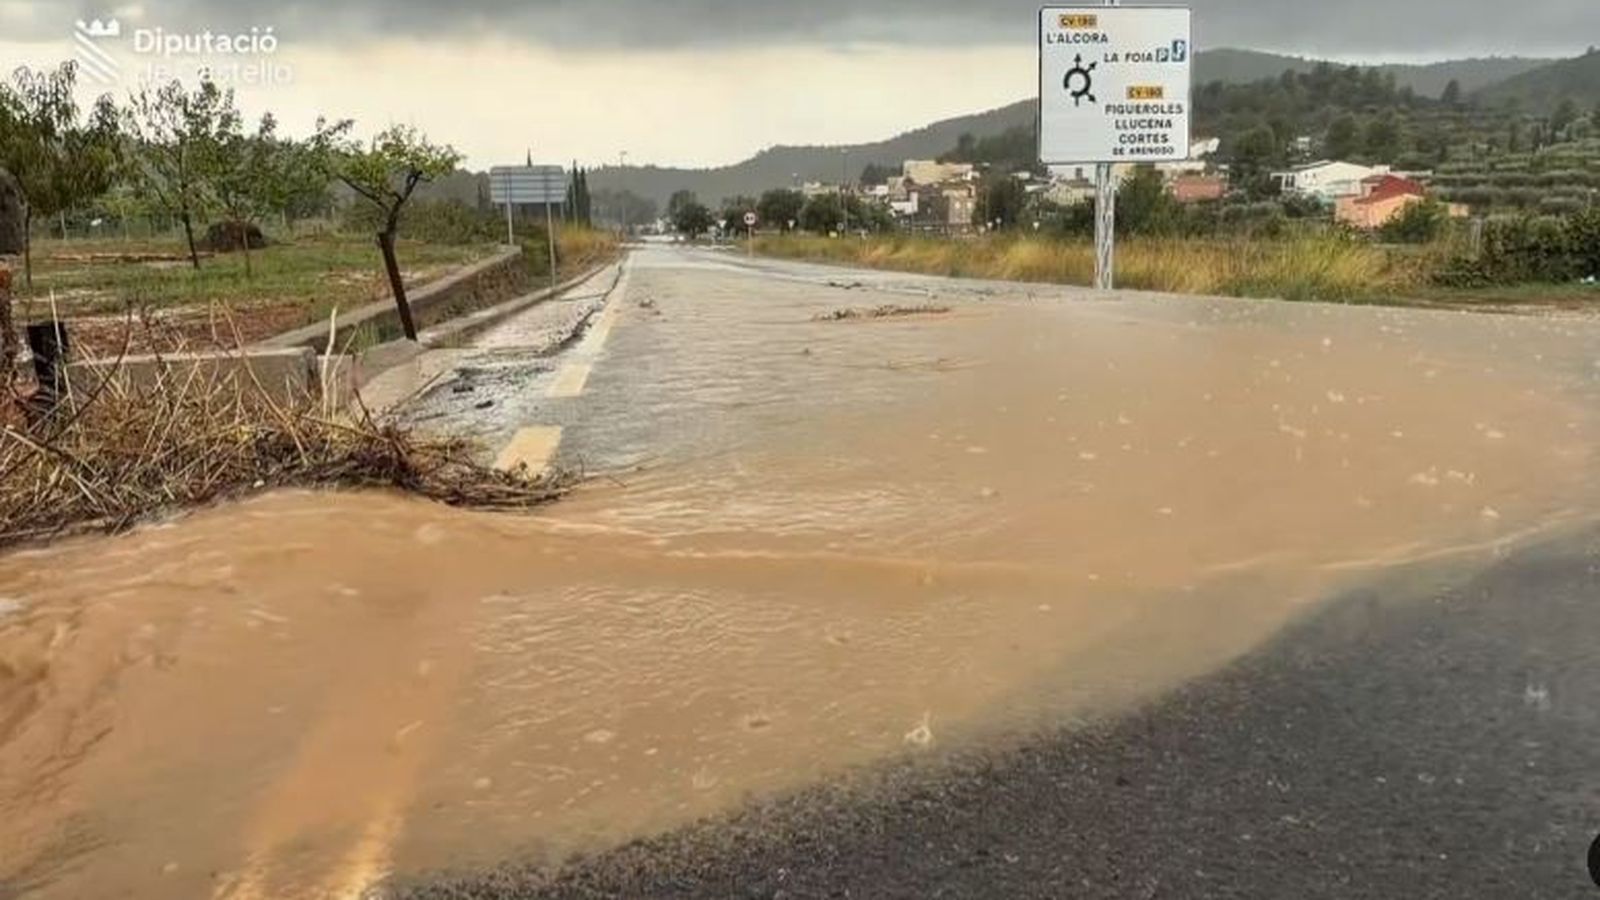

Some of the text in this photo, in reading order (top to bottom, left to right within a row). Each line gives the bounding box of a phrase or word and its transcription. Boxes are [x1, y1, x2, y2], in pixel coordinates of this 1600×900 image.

[1046, 33, 1108, 44] L'ALCORA
[1104, 53, 1119, 63] LA
[1125, 52, 1153, 63] FOIA
[1105, 104, 1183, 115] FIGUEROLES
[1114, 119, 1173, 130] LLUCENA
